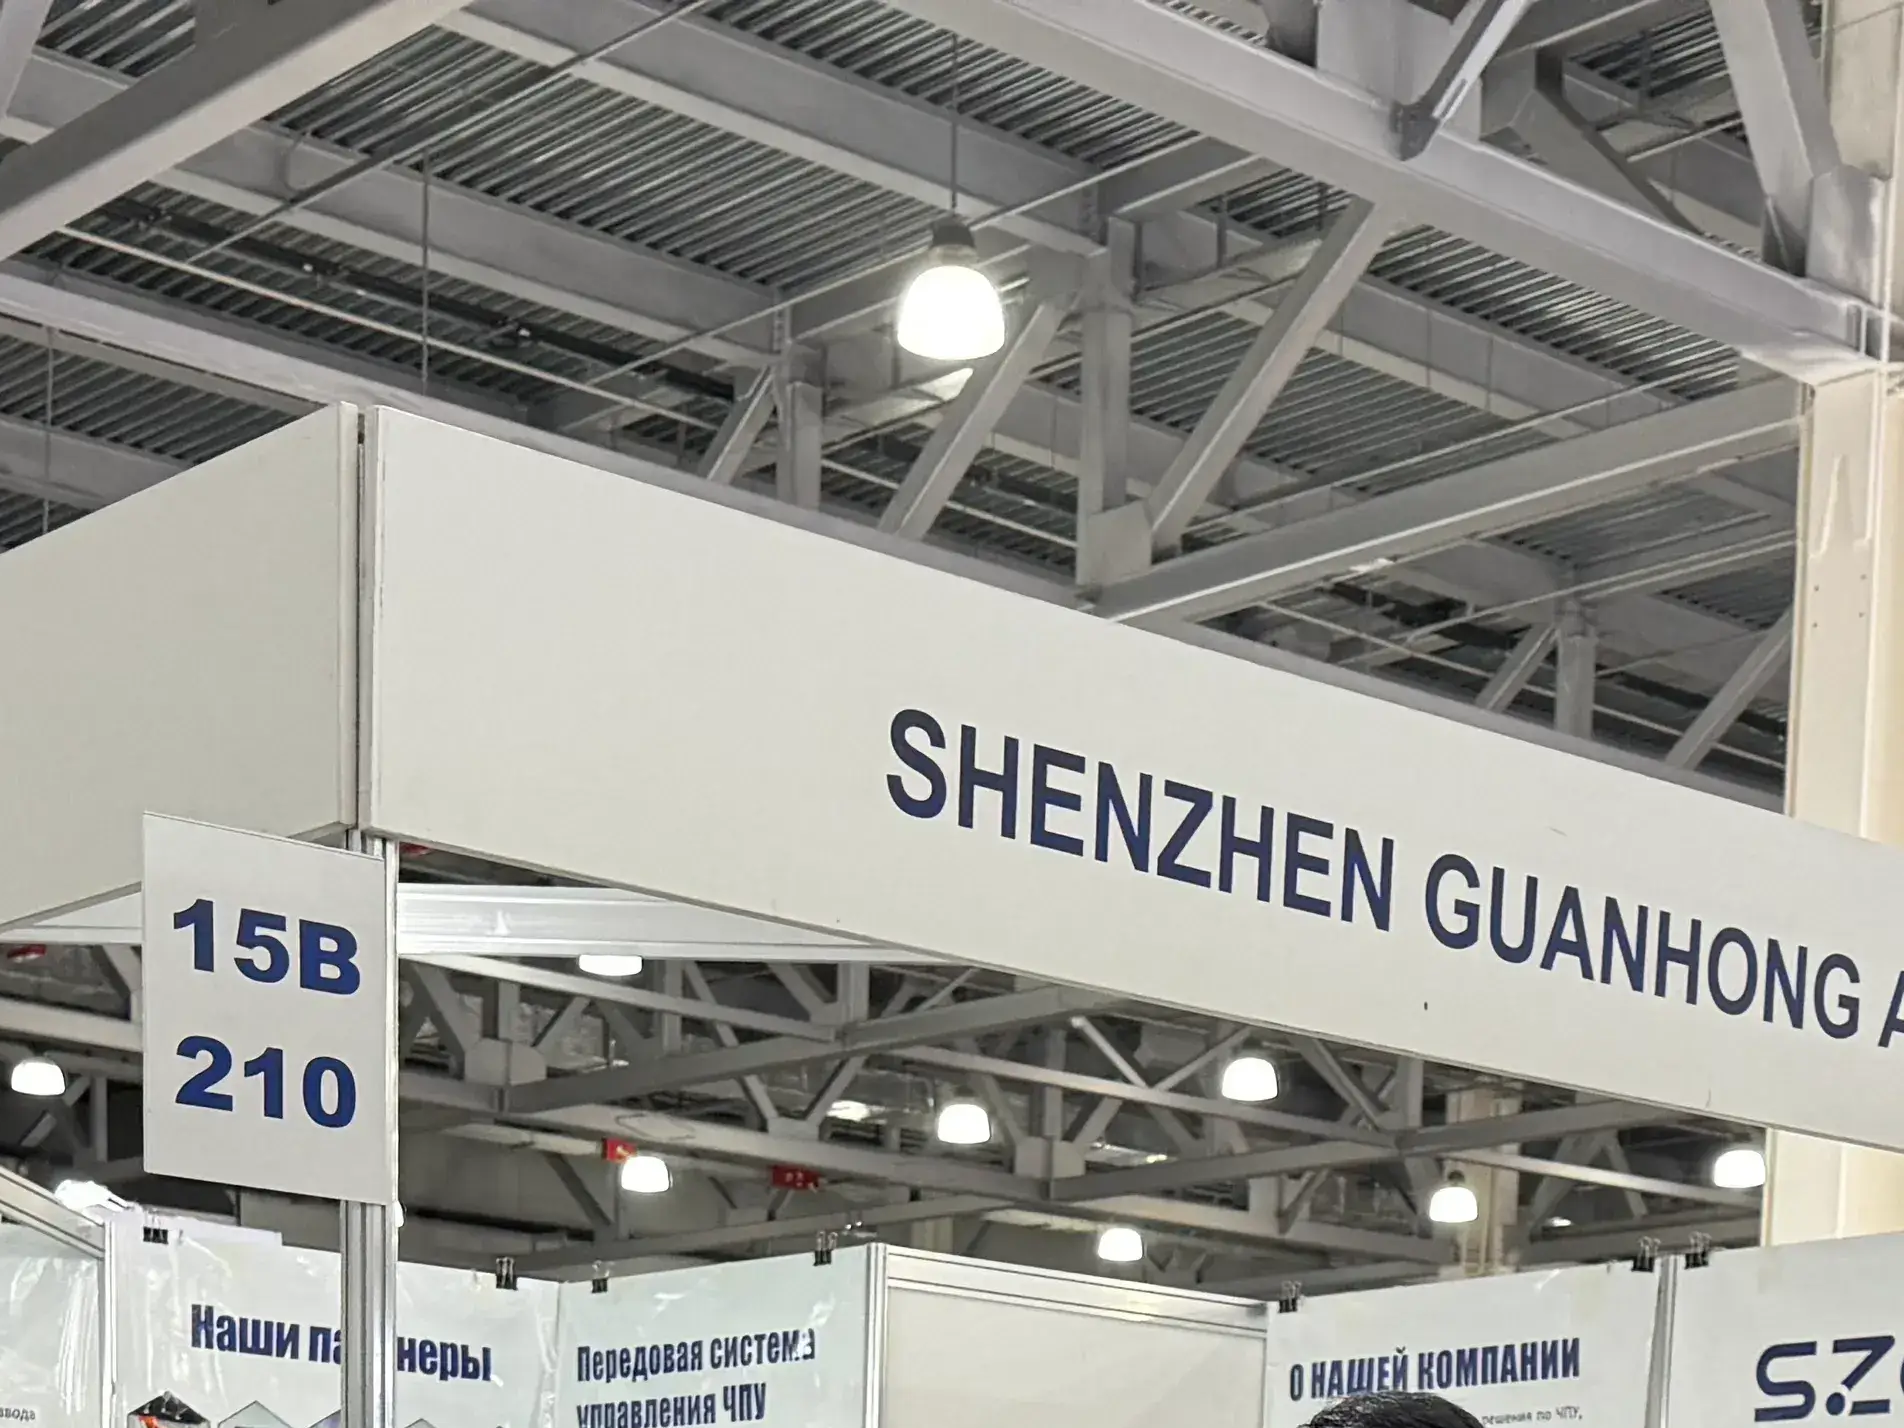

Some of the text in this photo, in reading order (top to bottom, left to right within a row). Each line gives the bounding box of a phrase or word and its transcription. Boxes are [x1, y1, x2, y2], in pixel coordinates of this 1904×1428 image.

[886, 708, 1395, 933] SHENZHEN
[1424, 852, 1860, 1039] GUANHONG
[173, 898, 361, 995] 15B
[175, 1035, 357, 1129] 210
[191, 1304, 300, 1359] Наши
[576, 1340, 703, 1384] Передовая
[1310, 1347, 1408, 1399] НАШЕЙ
[1418, 1338, 1581, 1391] КОМПАНИИ
[722, 1382, 767, 1422] ЧПУ
